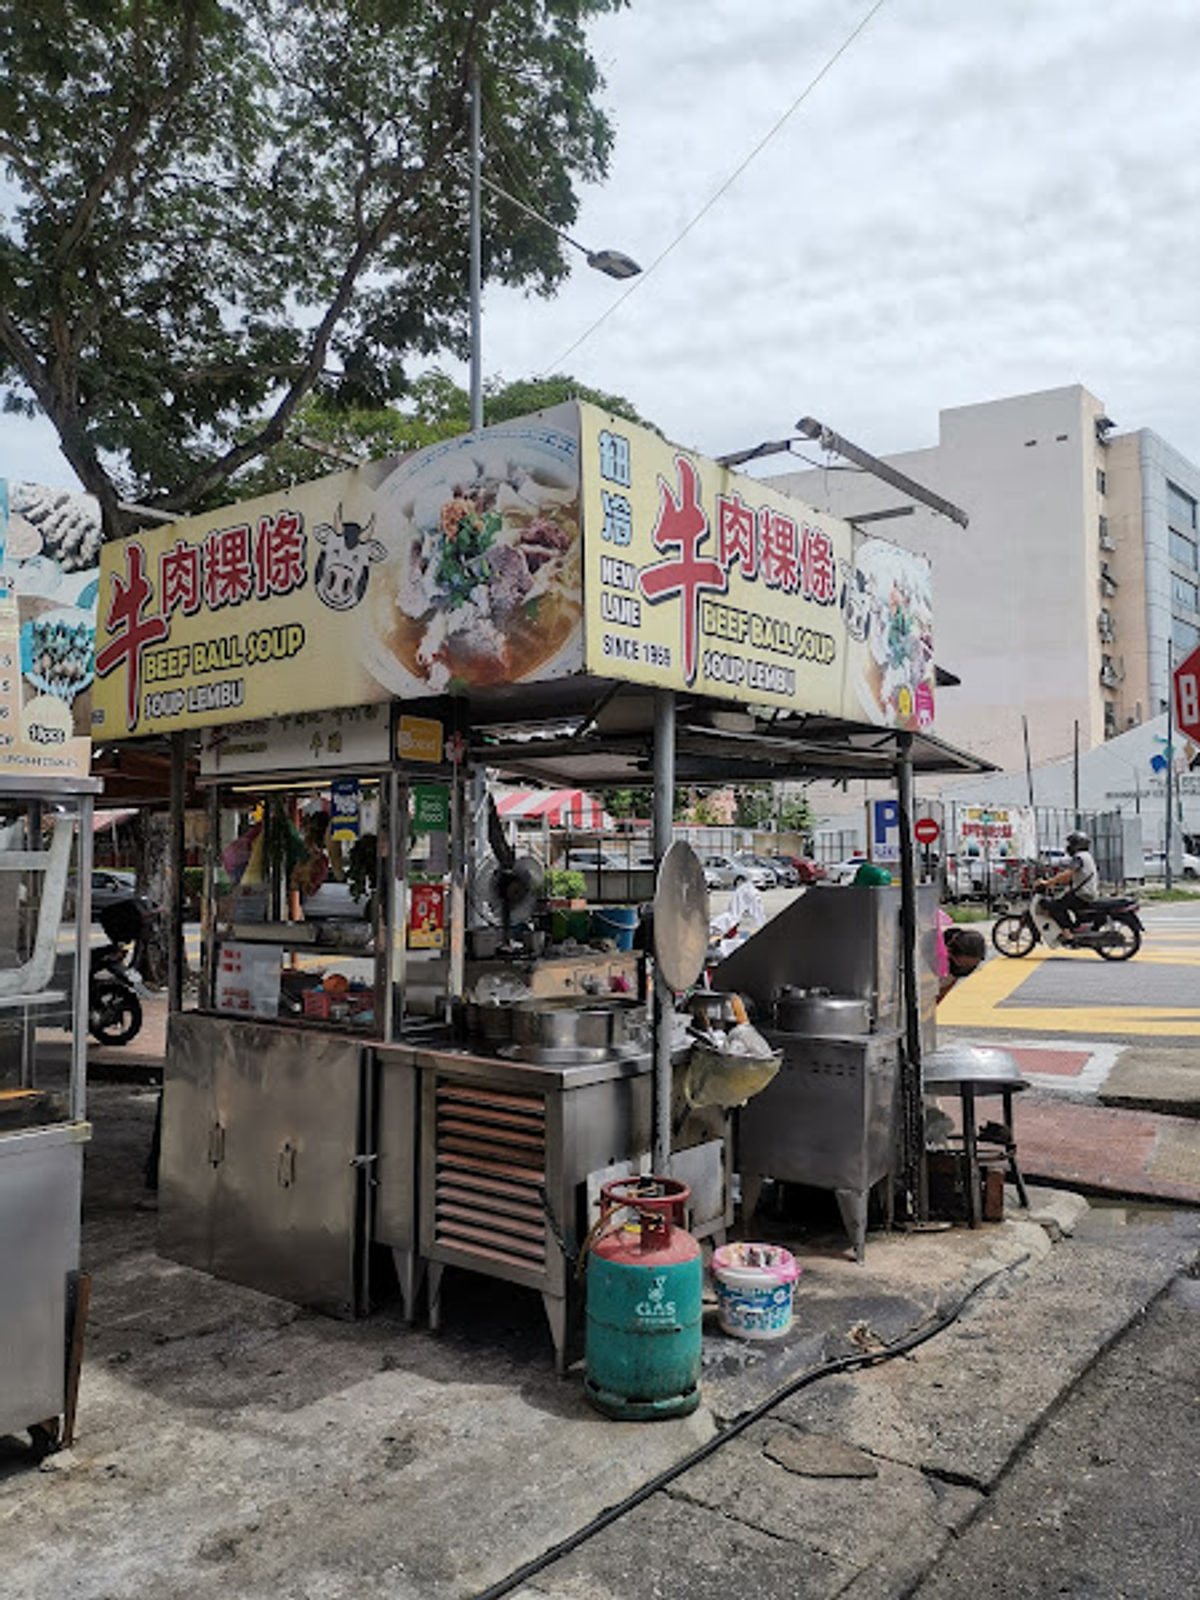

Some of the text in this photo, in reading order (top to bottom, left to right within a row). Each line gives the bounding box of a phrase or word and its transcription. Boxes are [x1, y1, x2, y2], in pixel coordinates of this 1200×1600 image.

[601, 555, 637, 591] NEW
[96, 511, 305, 731] 牛肉粿條
[601, 592, 640, 627] LANE
[144, 623, 304, 683] BEEF BALL SOUP
[603, 634, 639, 660] SINCE
[702, 599, 836, 664] BEEF BALL SOUP
[703, 650, 796, 695] SOUP LEMBU
[145, 679, 244, 719] SOUP LEMBU
[875, 801, 900, 844] P
